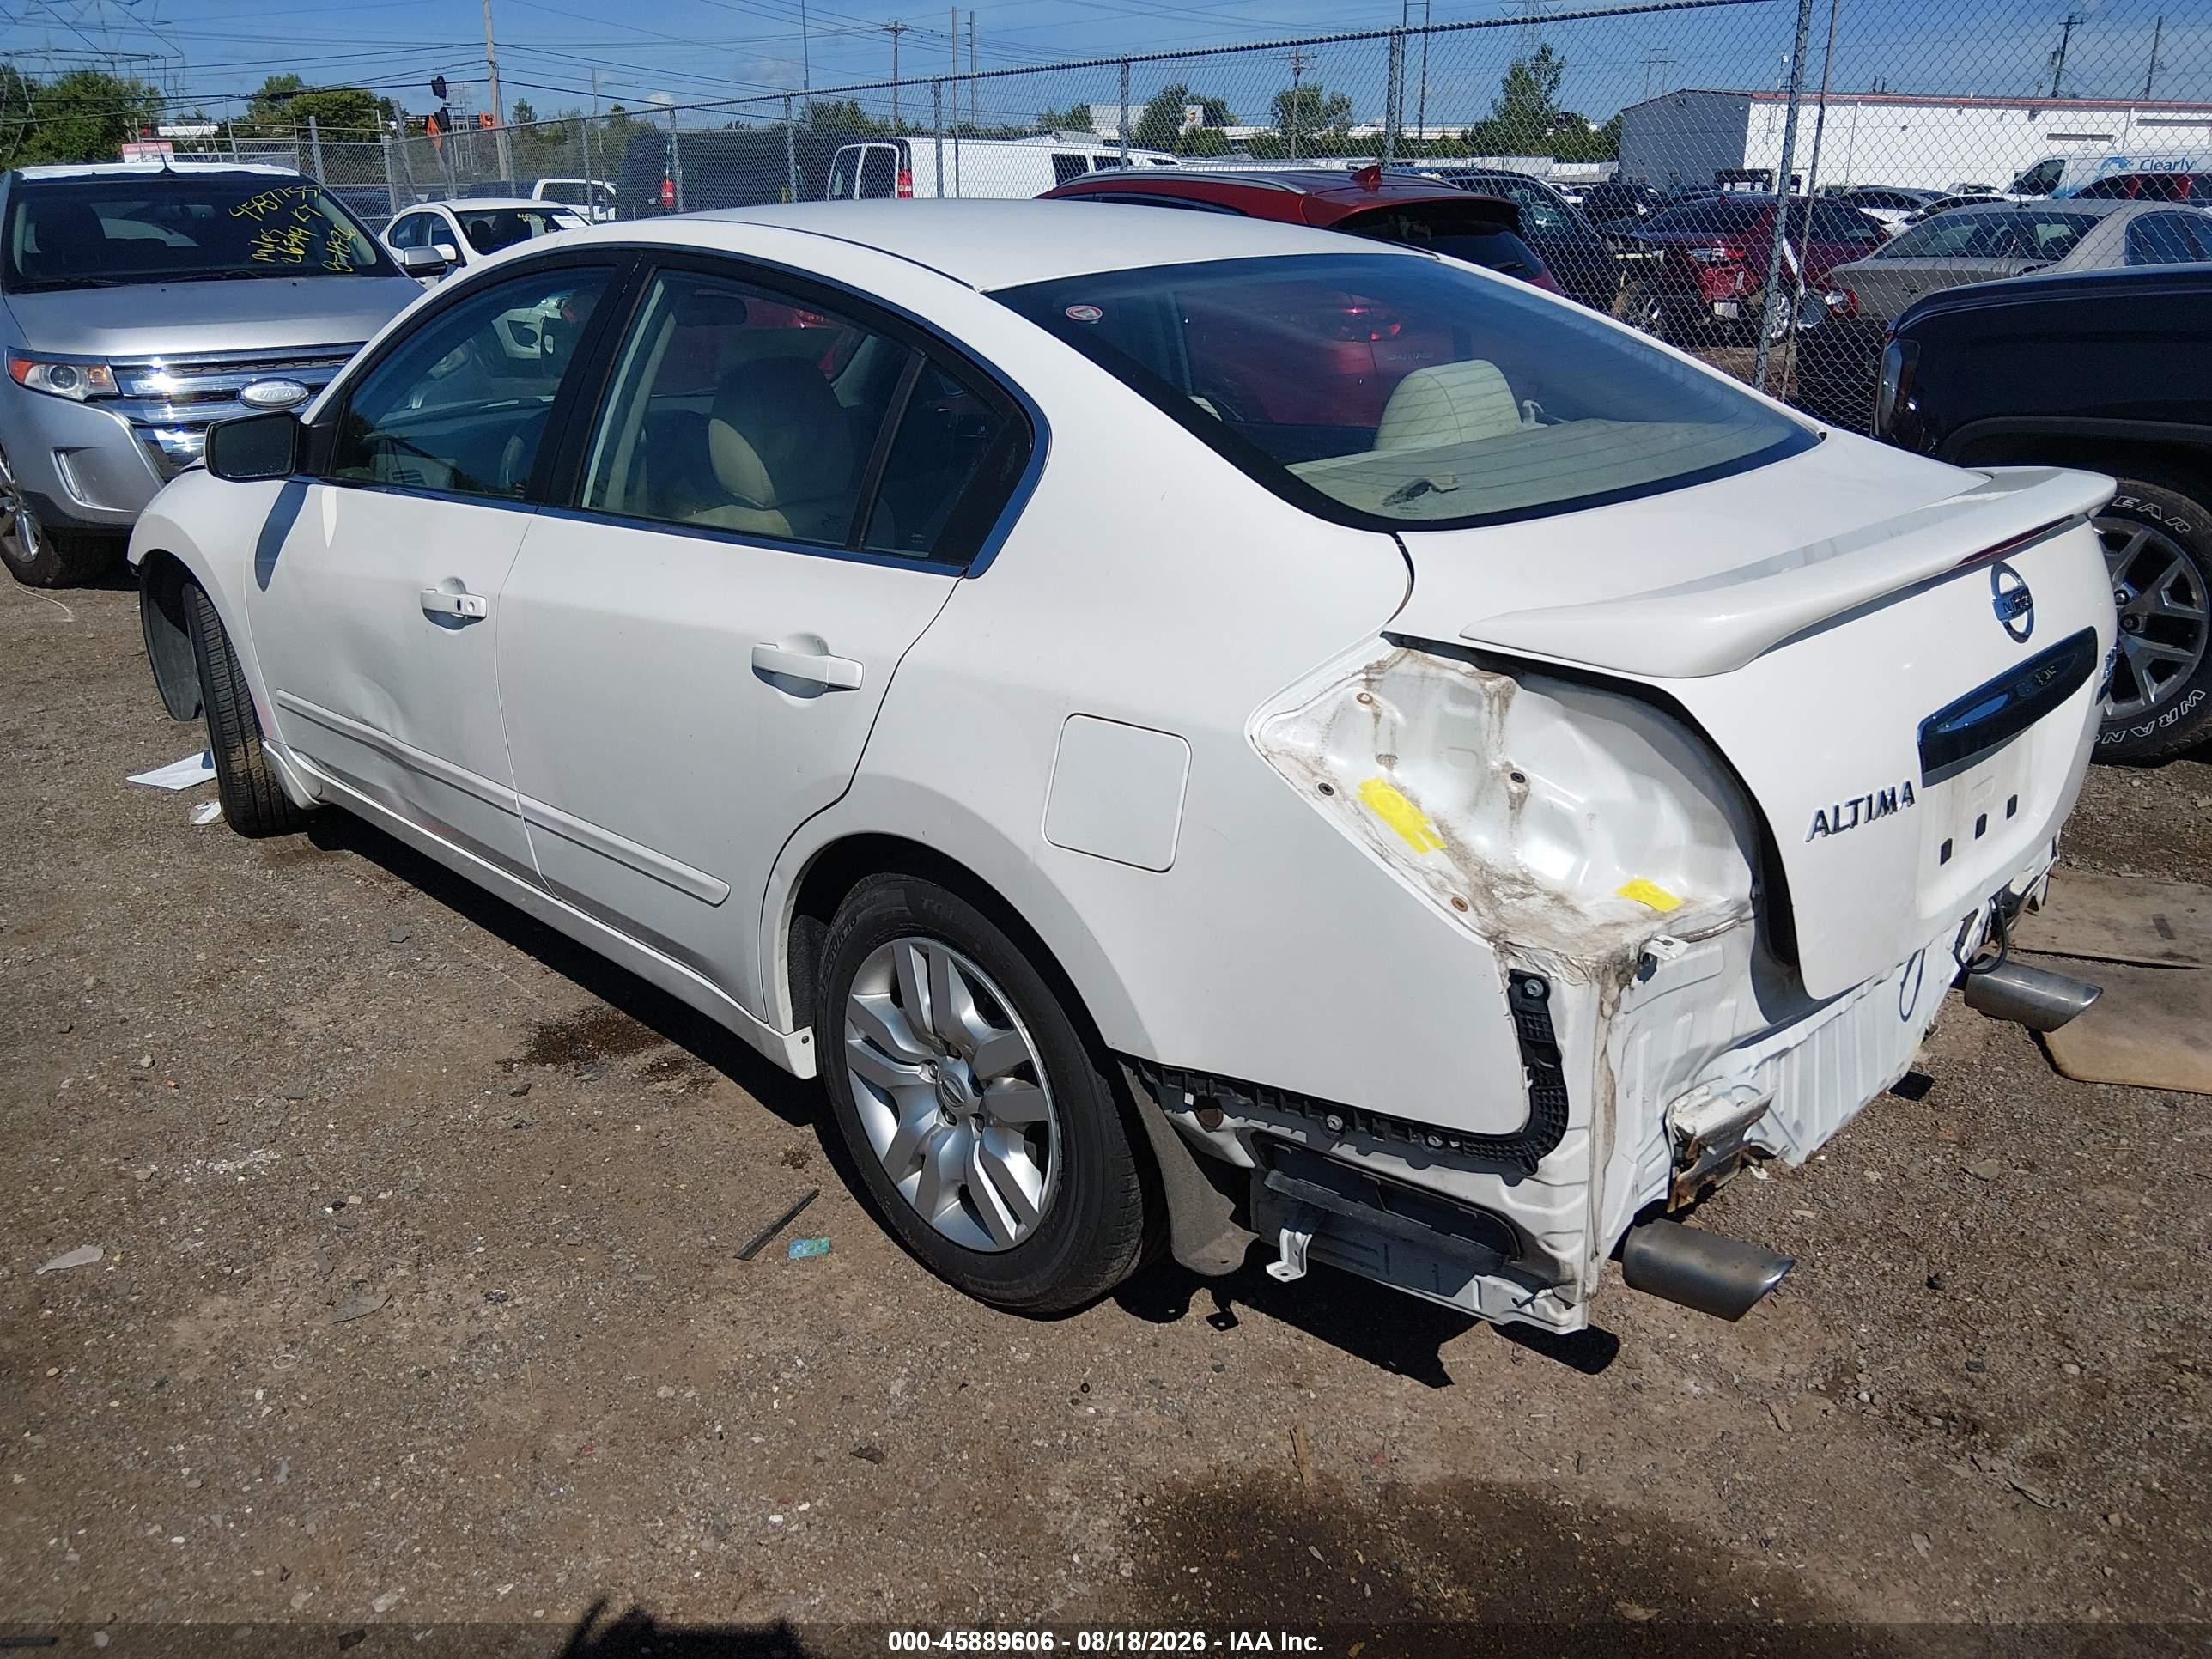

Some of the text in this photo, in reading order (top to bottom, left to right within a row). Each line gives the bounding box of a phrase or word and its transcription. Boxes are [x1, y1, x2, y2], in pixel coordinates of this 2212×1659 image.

[2139, 158, 2194, 173] Clearly
[2095, 690, 2206, 744] WRAN
[1804, 779, 1916, 843] ALTIMA
